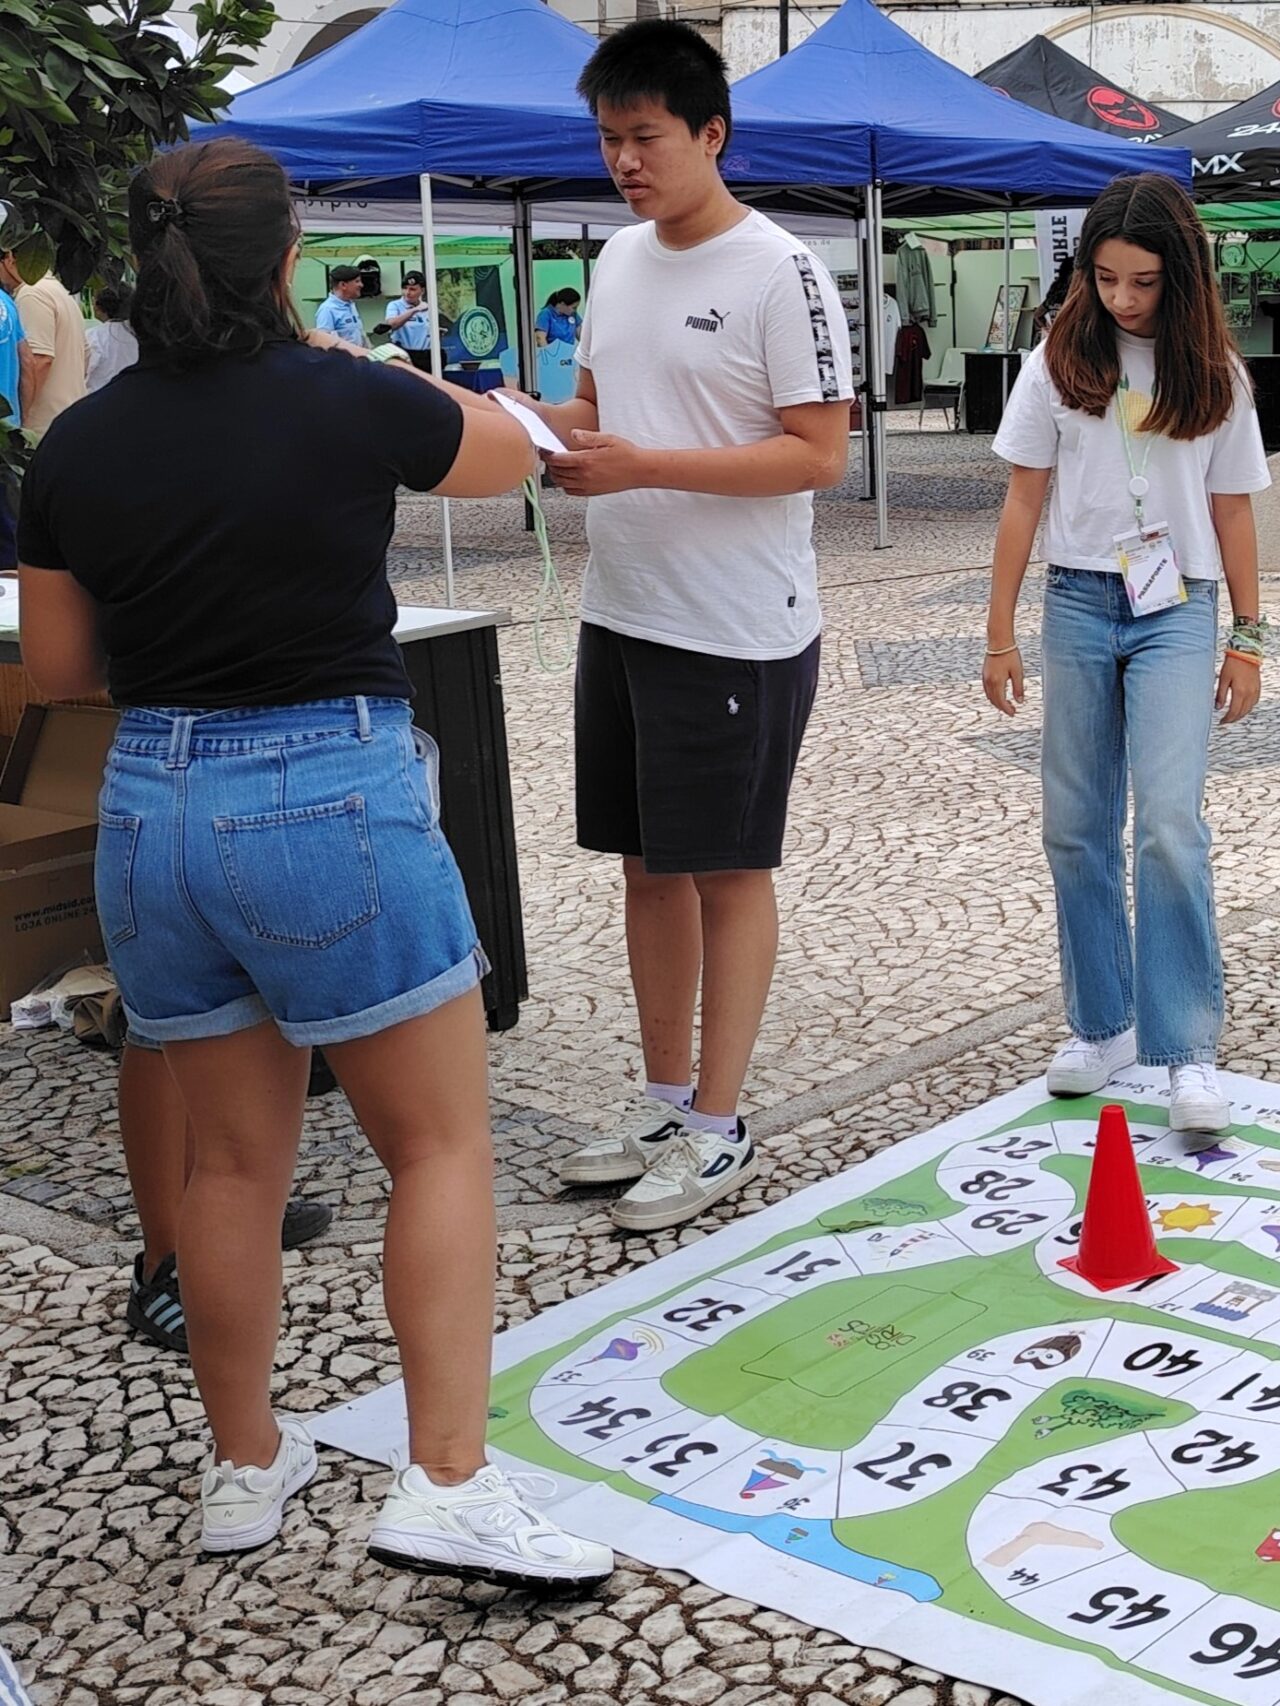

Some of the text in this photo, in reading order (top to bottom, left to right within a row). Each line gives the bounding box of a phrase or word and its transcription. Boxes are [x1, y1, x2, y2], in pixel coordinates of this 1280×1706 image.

[1191, 151, 1246, 177] MX
[684, 315, 719, 333] PUMA
[960, 1170, 1035, 1201] 28
[970, 1209, 1049, 1236] 29
[764, 1249, 841, 1282] 31
[663, 1297, 746, 1332] 32
[1123, 1342, 1203, 1378] 40
[558, 1396, 652, 1441] 34
[923, 1381, 1012, 1422] 38
[622, 1433, 719, 1478] 35
[852, 1441, 952, 1492] 37
[1170, 1429, 1260, 1474] 42
[1038, 1463, 1131, 1501] 43
[1067, 1586, 1171, 1630] 45
